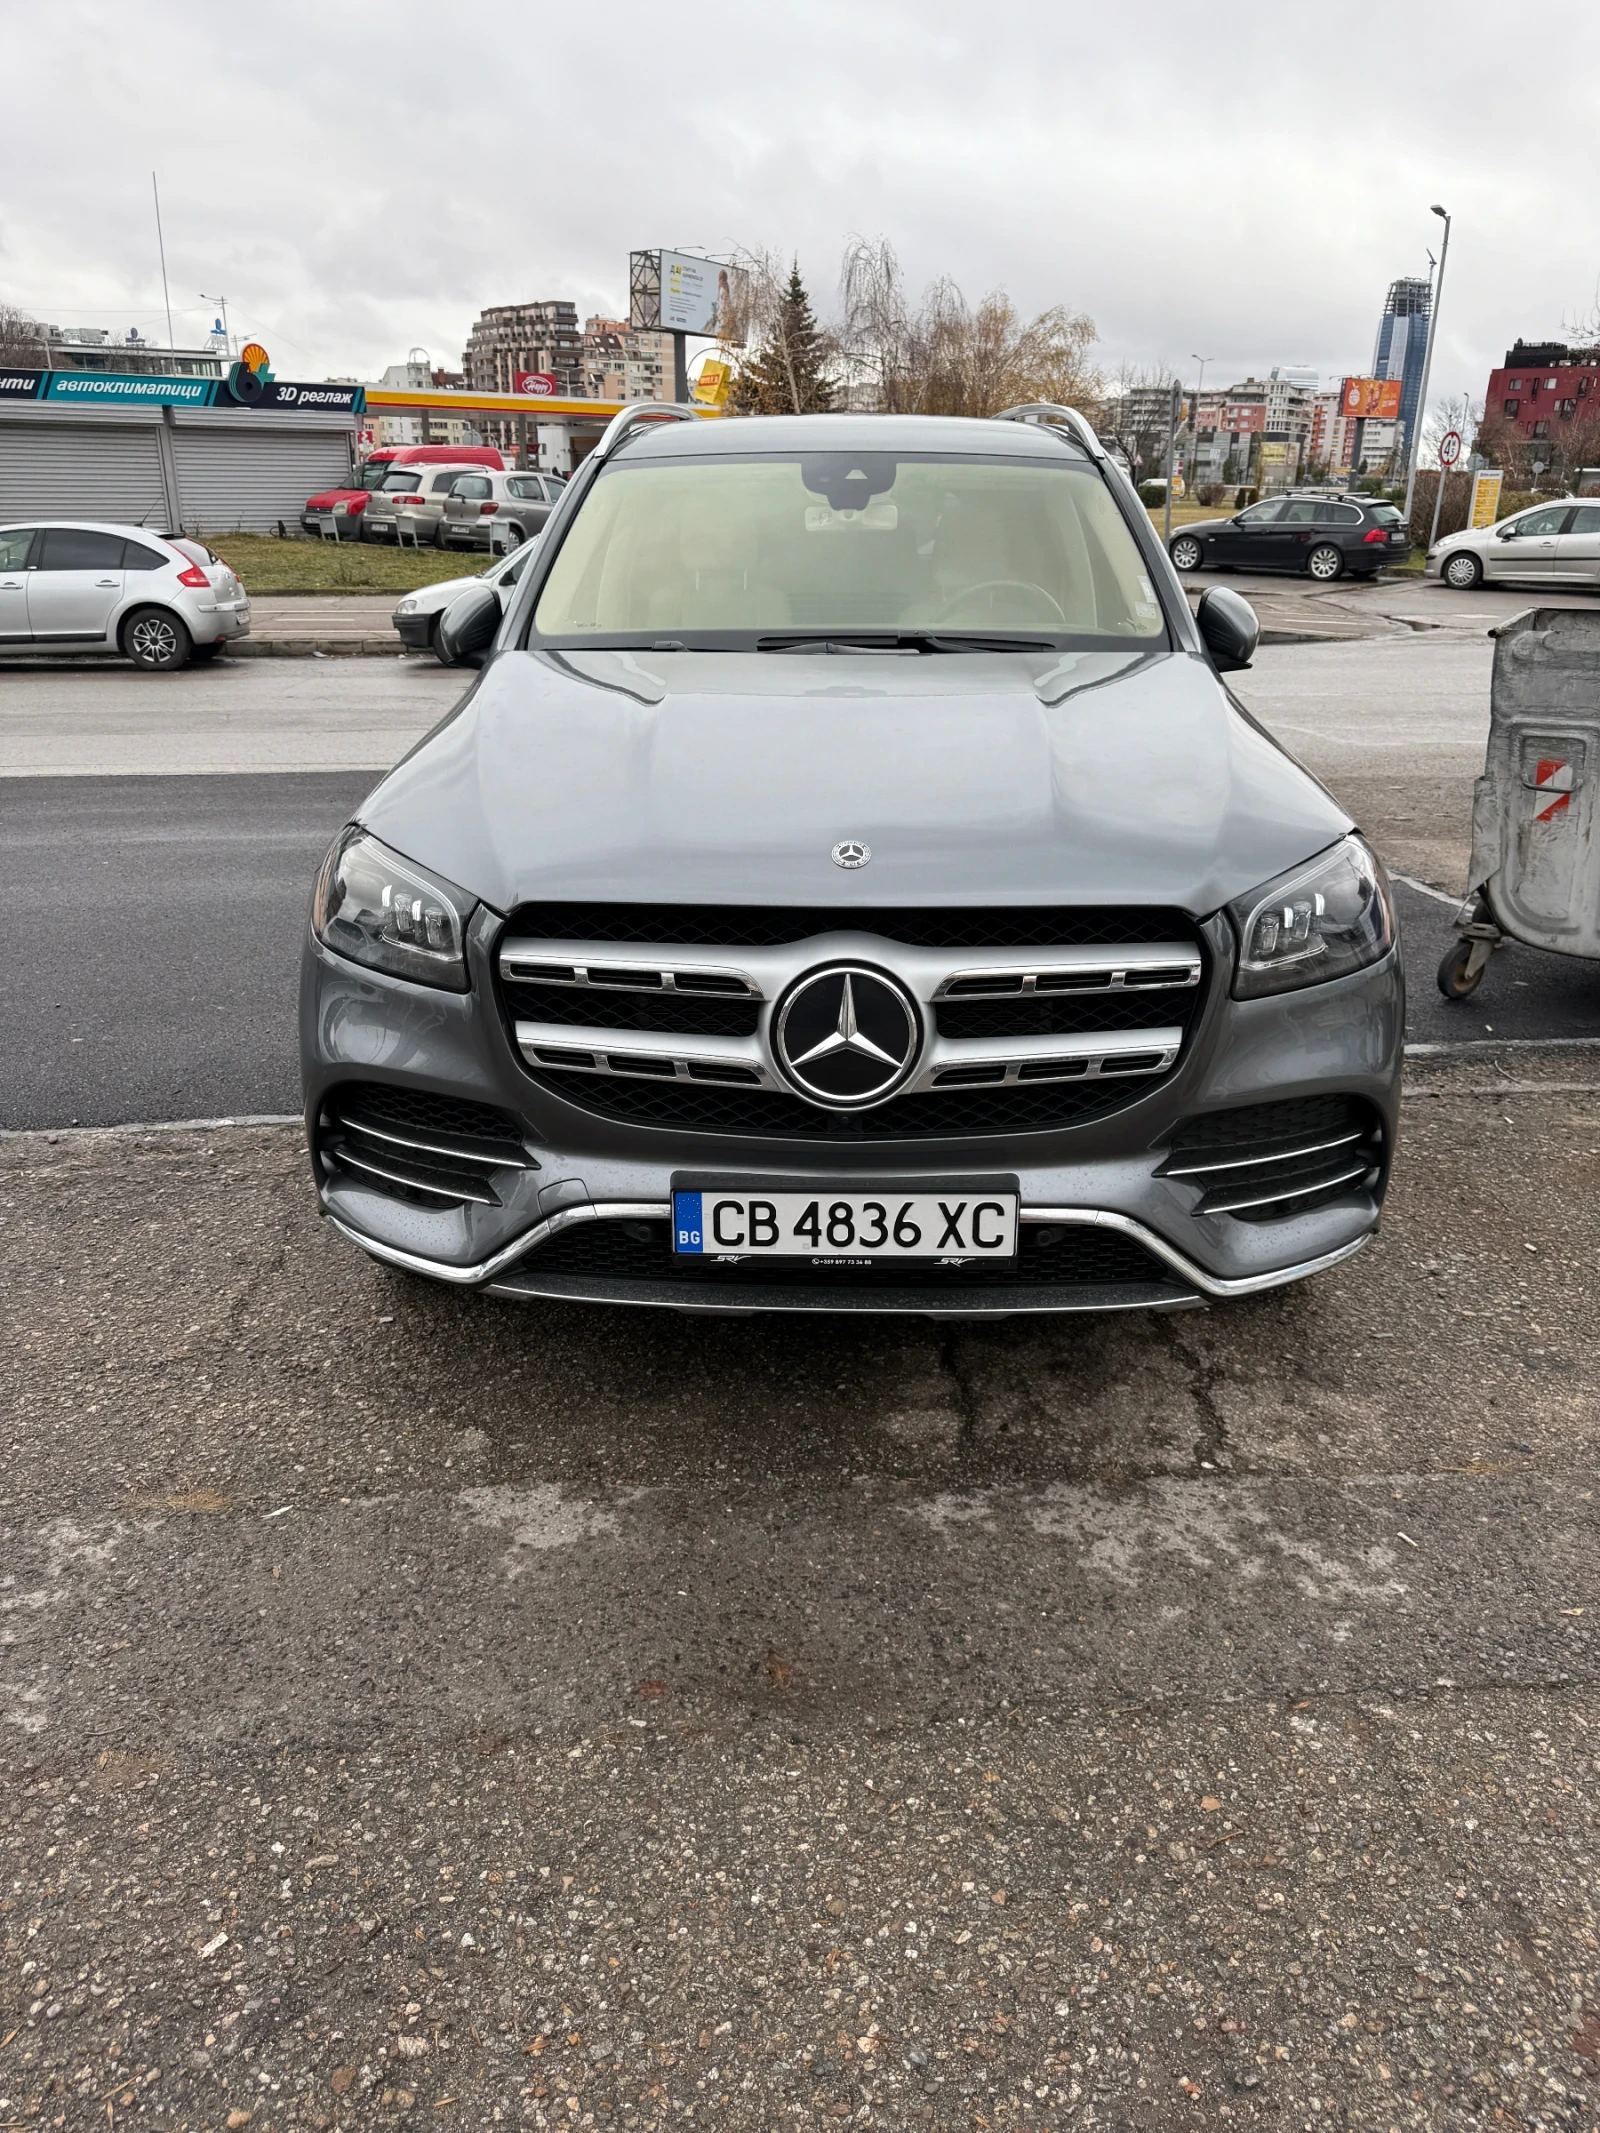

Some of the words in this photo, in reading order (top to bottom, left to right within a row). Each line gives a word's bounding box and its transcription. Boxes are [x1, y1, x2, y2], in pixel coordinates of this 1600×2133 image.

[56, 379, 203, 399] автоклиматици
[276, 386, 297, 401] 3D
[297, 391, 353, 405] реглаж
[713, 1200, 780, 1247] CB
[793, 1201, 922, 1248] 4836
[936, 1202, 1005, 1248] XC
[679, 1230, 701, 1245] BG
